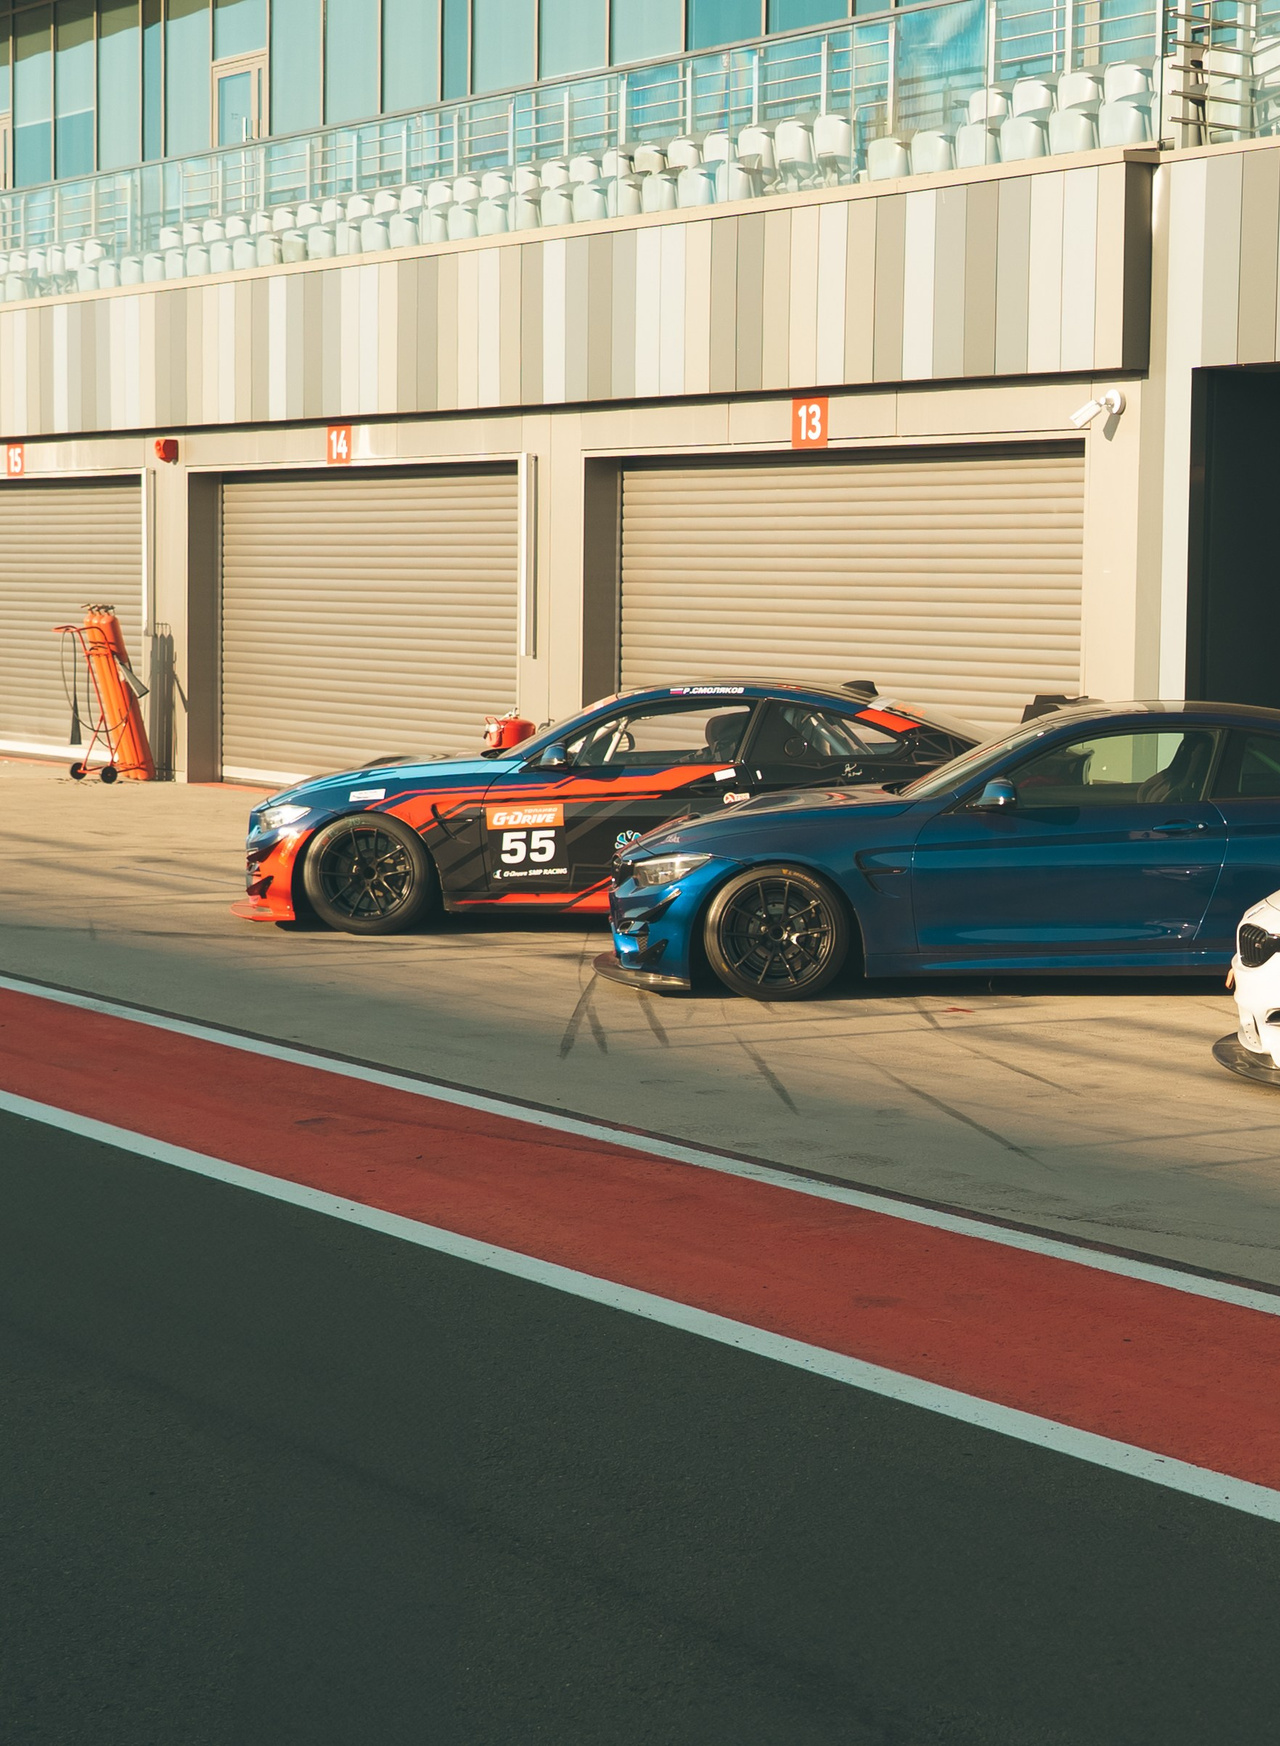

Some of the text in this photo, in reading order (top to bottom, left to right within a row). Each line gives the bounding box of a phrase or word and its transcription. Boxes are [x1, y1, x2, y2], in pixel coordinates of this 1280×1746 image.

[798, 404, 821, 440] 13
[9, 447, 22, 472] 15
[330, 430, 348, 459] 14
[500, 830, 556, 864] 55
